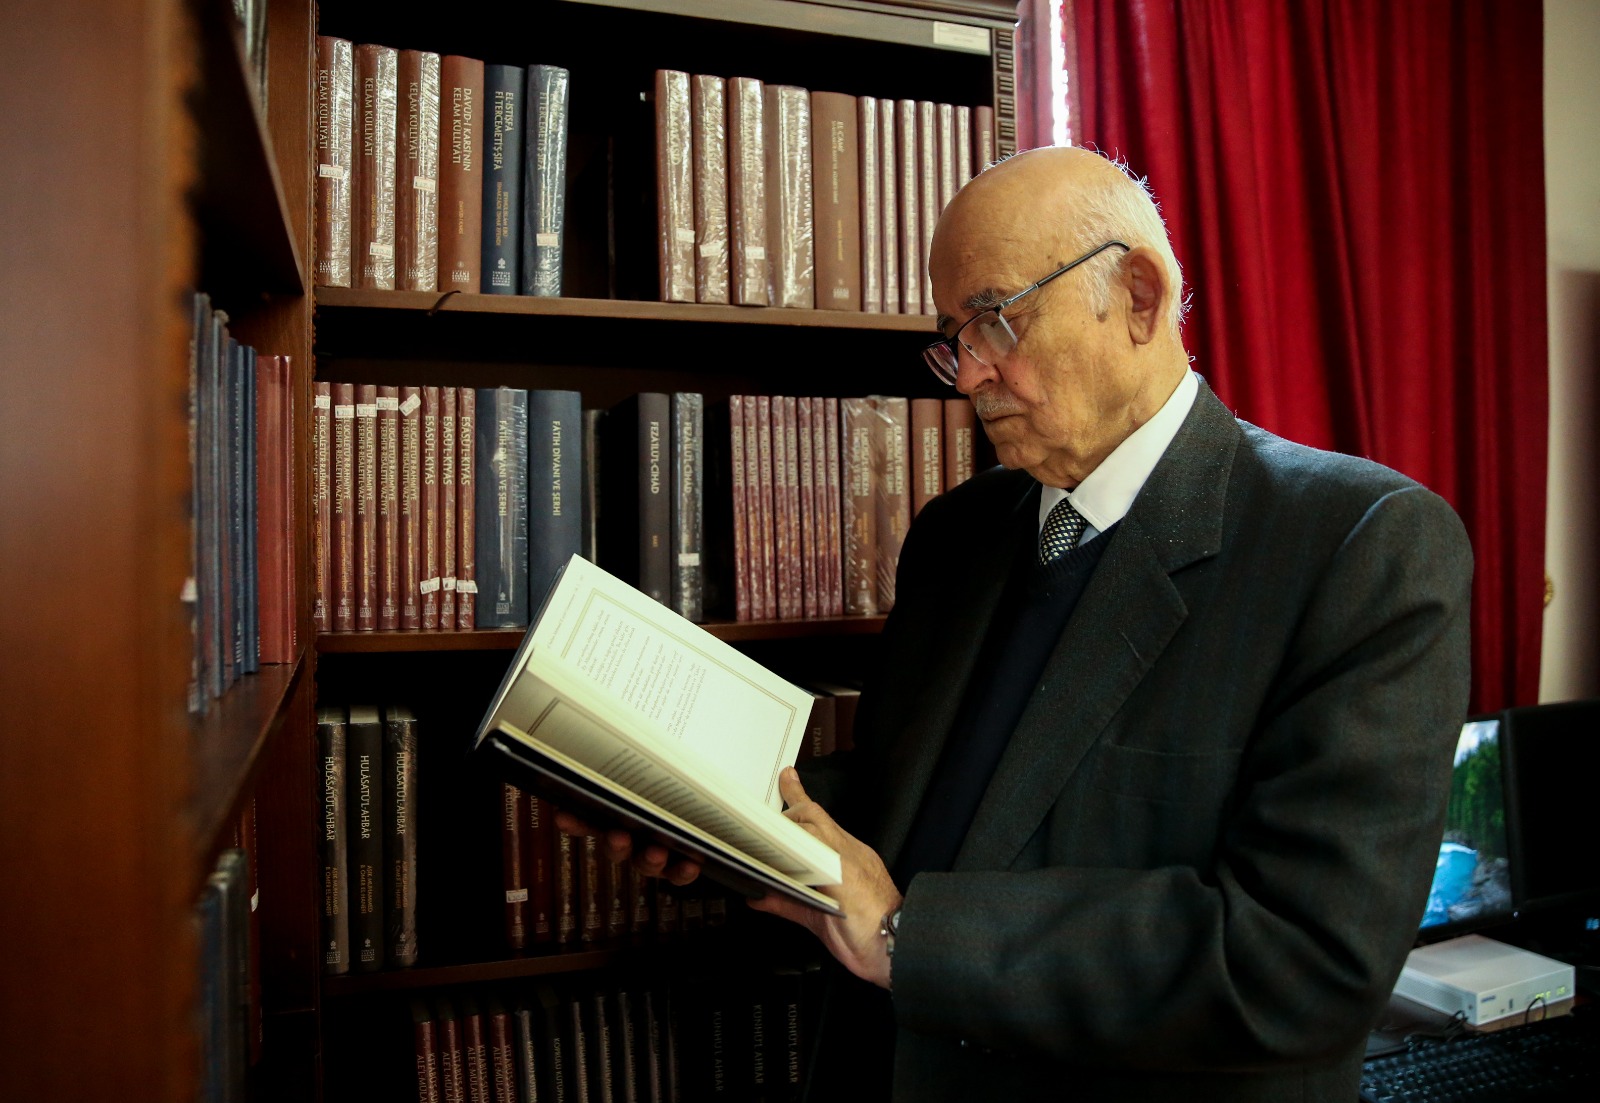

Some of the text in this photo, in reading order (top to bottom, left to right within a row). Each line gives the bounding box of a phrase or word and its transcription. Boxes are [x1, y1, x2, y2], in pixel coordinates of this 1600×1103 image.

[499, 479, 507, 490] VE
[552, 479, 561, 490] VE
[497, 492, 508, 516] ŞERHİ
[551, 492, 562, 516] ŞERHİ
